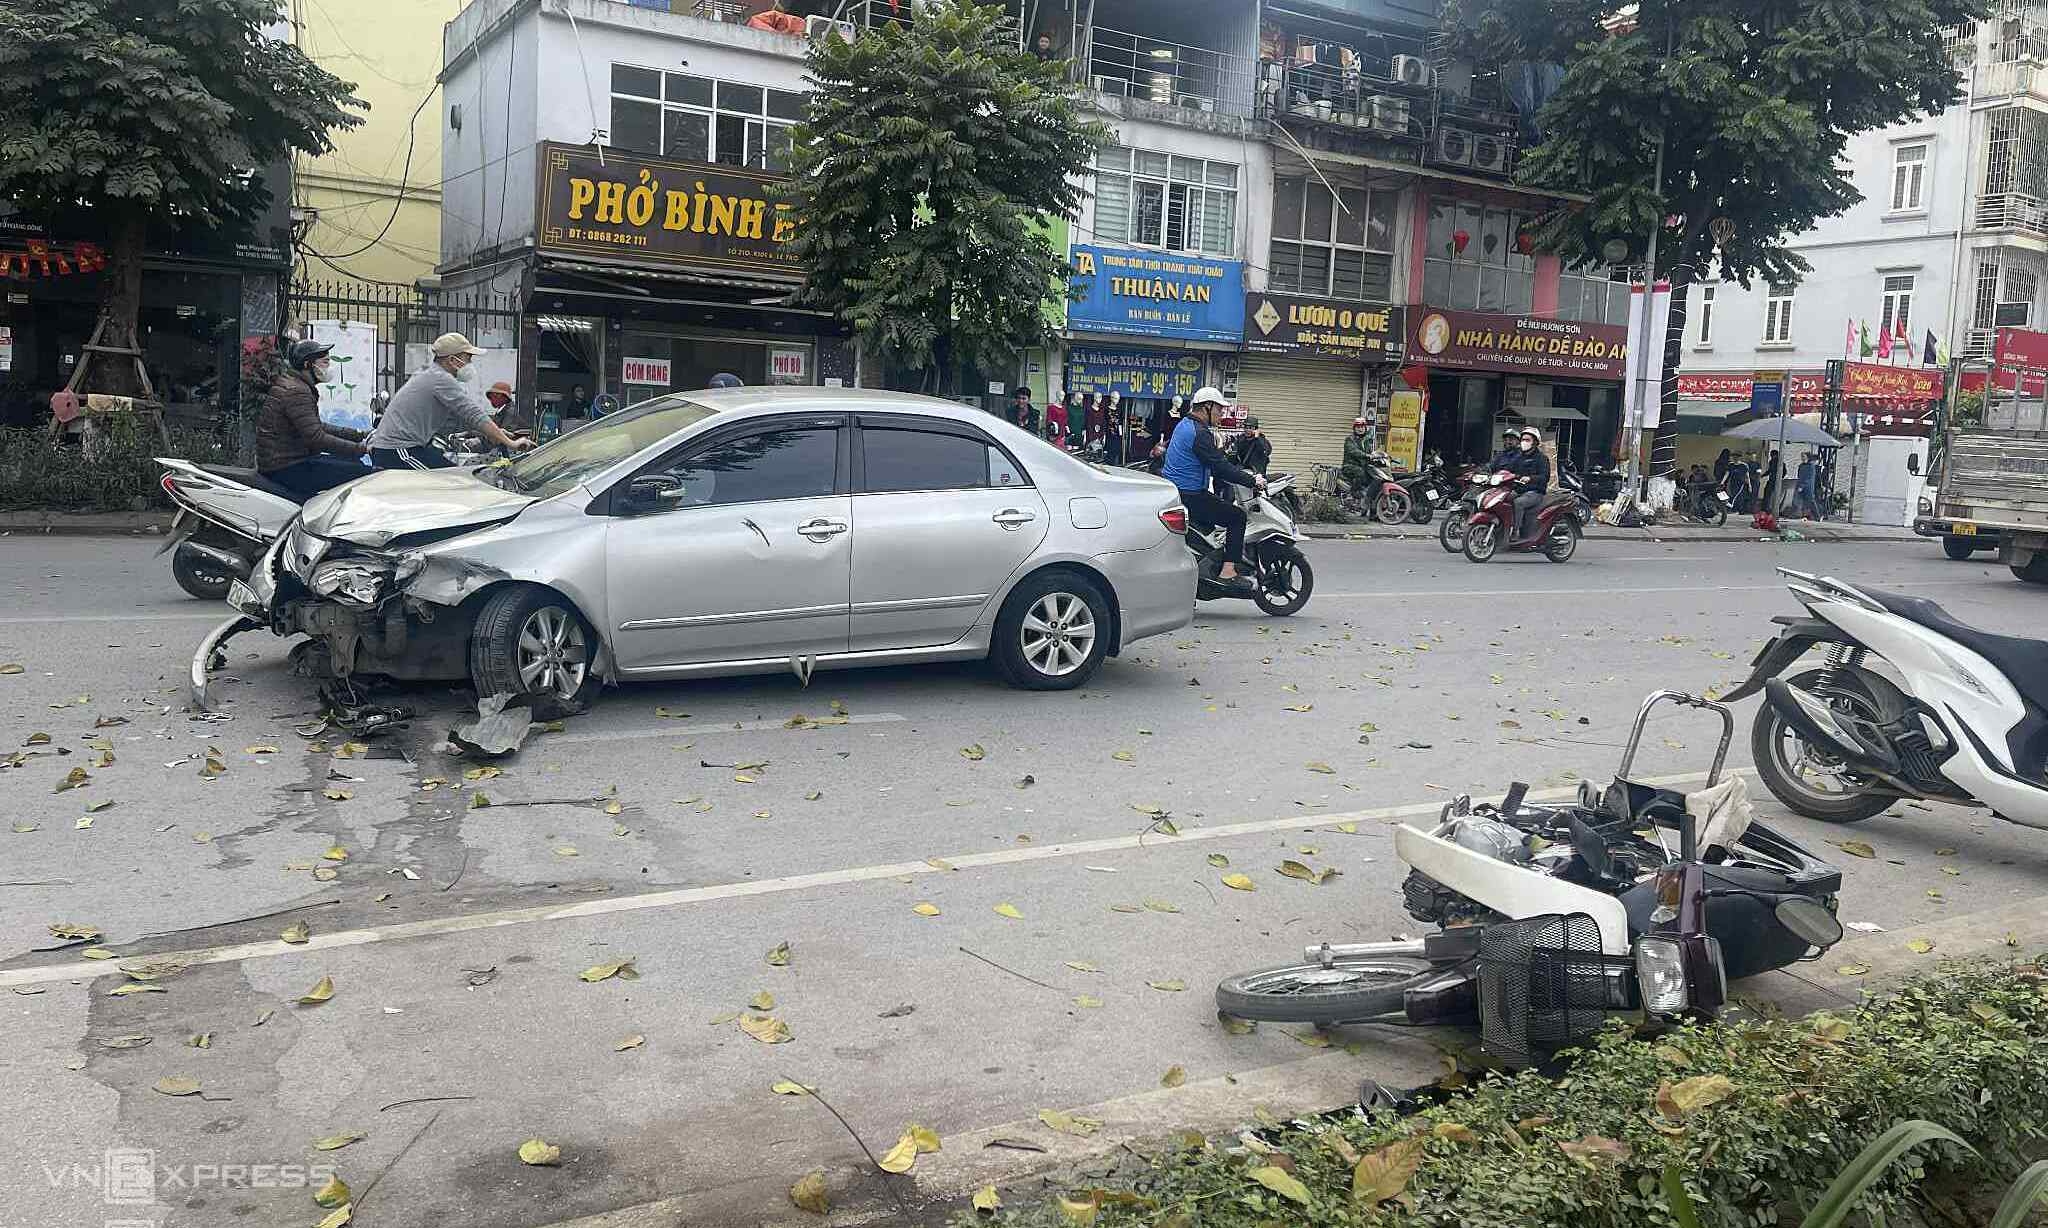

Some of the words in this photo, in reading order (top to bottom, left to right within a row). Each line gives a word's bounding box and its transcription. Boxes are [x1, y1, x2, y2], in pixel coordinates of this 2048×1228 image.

[568, 168, 659, 227] PHỞ
[662, 182, 766, 240] BÌNH
[633, 235, 648, 246] 111
[1076, 252, 1097, 276] TA
[1112, 277, 1180, 304] THUẬN
[1183, 284, 1211, 304] AN
[1288, 304, 1337, 327] LƯƠN
[1339, 310, 1352, 329] O
[1456, 328, 1494, 347] NHÀ
[1498, 329, 1546, 353] HÀNG
[1549, 335, 1571, 355] DÊ
[1089, 352, 1118, 365] HÀNG
